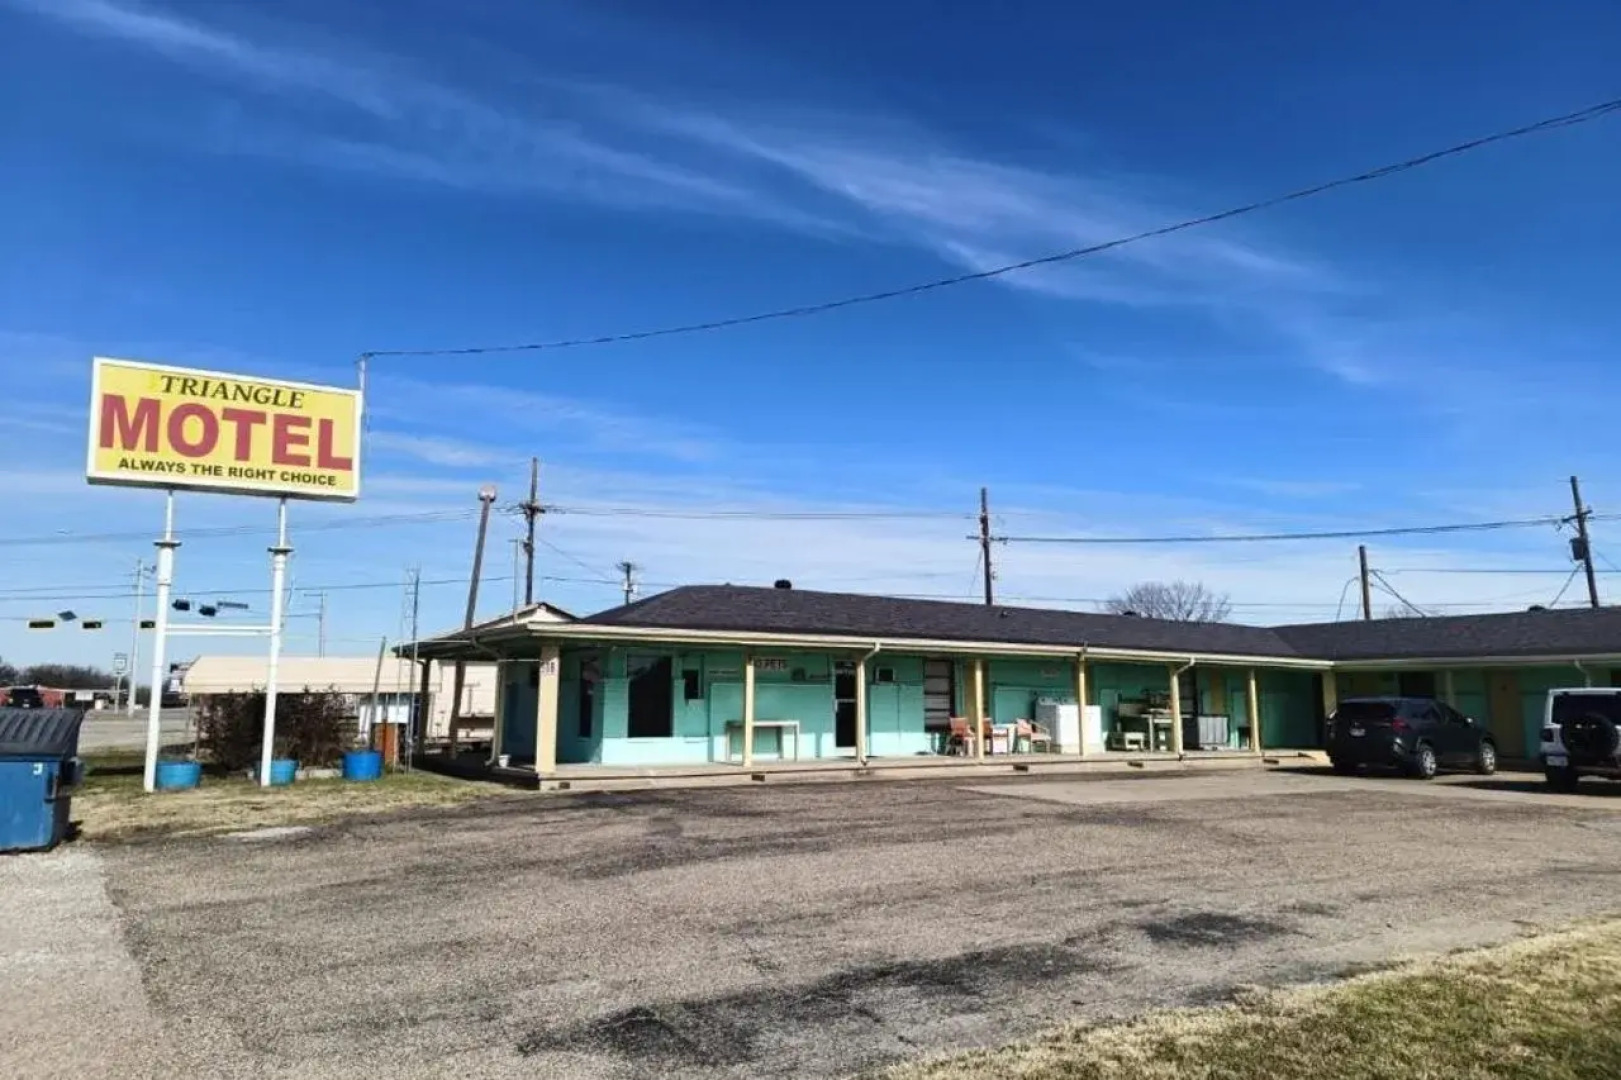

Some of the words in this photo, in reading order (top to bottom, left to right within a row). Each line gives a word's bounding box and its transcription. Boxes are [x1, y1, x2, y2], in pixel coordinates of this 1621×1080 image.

[161, 375, 305, 408] TRIANGLE
[99, 393, 354, 471] MOTEL
[118, 457, 186, 472] ALWAYS
[192, 463, 222, 477] THE
[228, 466, 276, 481] RIGHT
[280, 471, 336, 486] CHOICE
